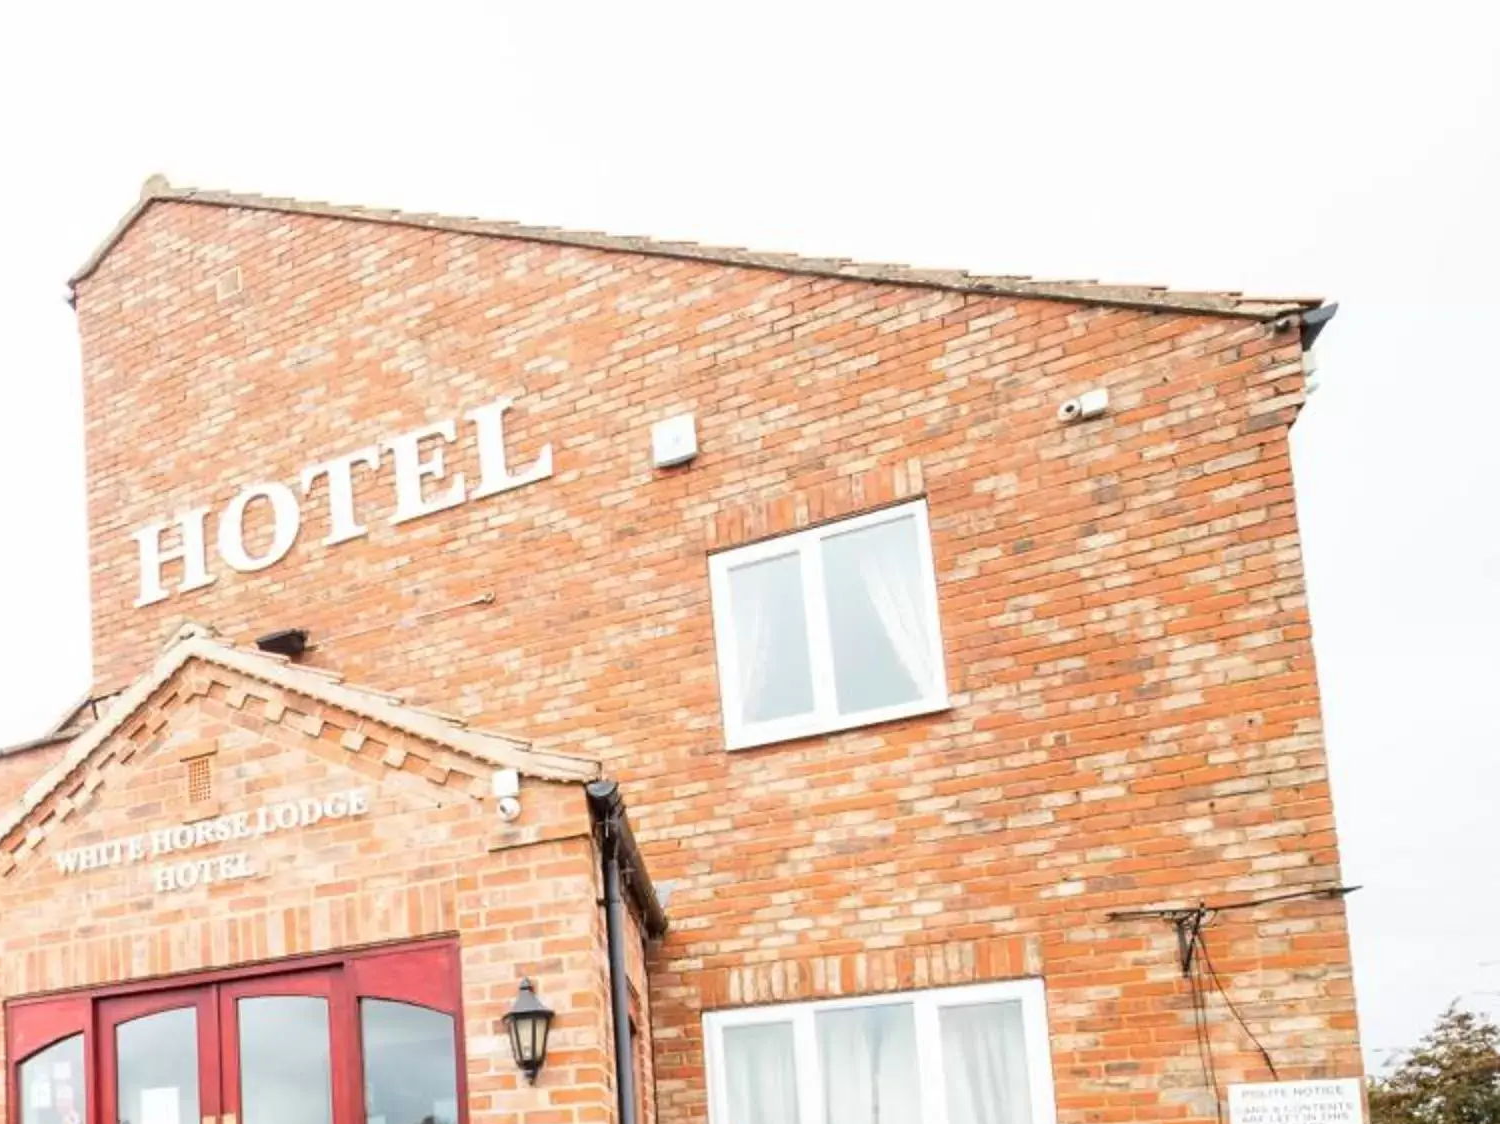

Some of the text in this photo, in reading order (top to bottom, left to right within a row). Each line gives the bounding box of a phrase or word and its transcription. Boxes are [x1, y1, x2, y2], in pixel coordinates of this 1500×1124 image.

[133, 397, 553, 609] HOTEL
[54, 789, 369, 874] WHITE HORSE LODGE
[155, 852, 258, 891] HOTEL
[1241, 1084, 1344, 1099] POLITE NOTICE
[1269, 1112, 1299, 1123] LEFT
[1320, 1110, 1349, 1121] THIS
[1283, 1101, 1354, 1113] CONTENTS
